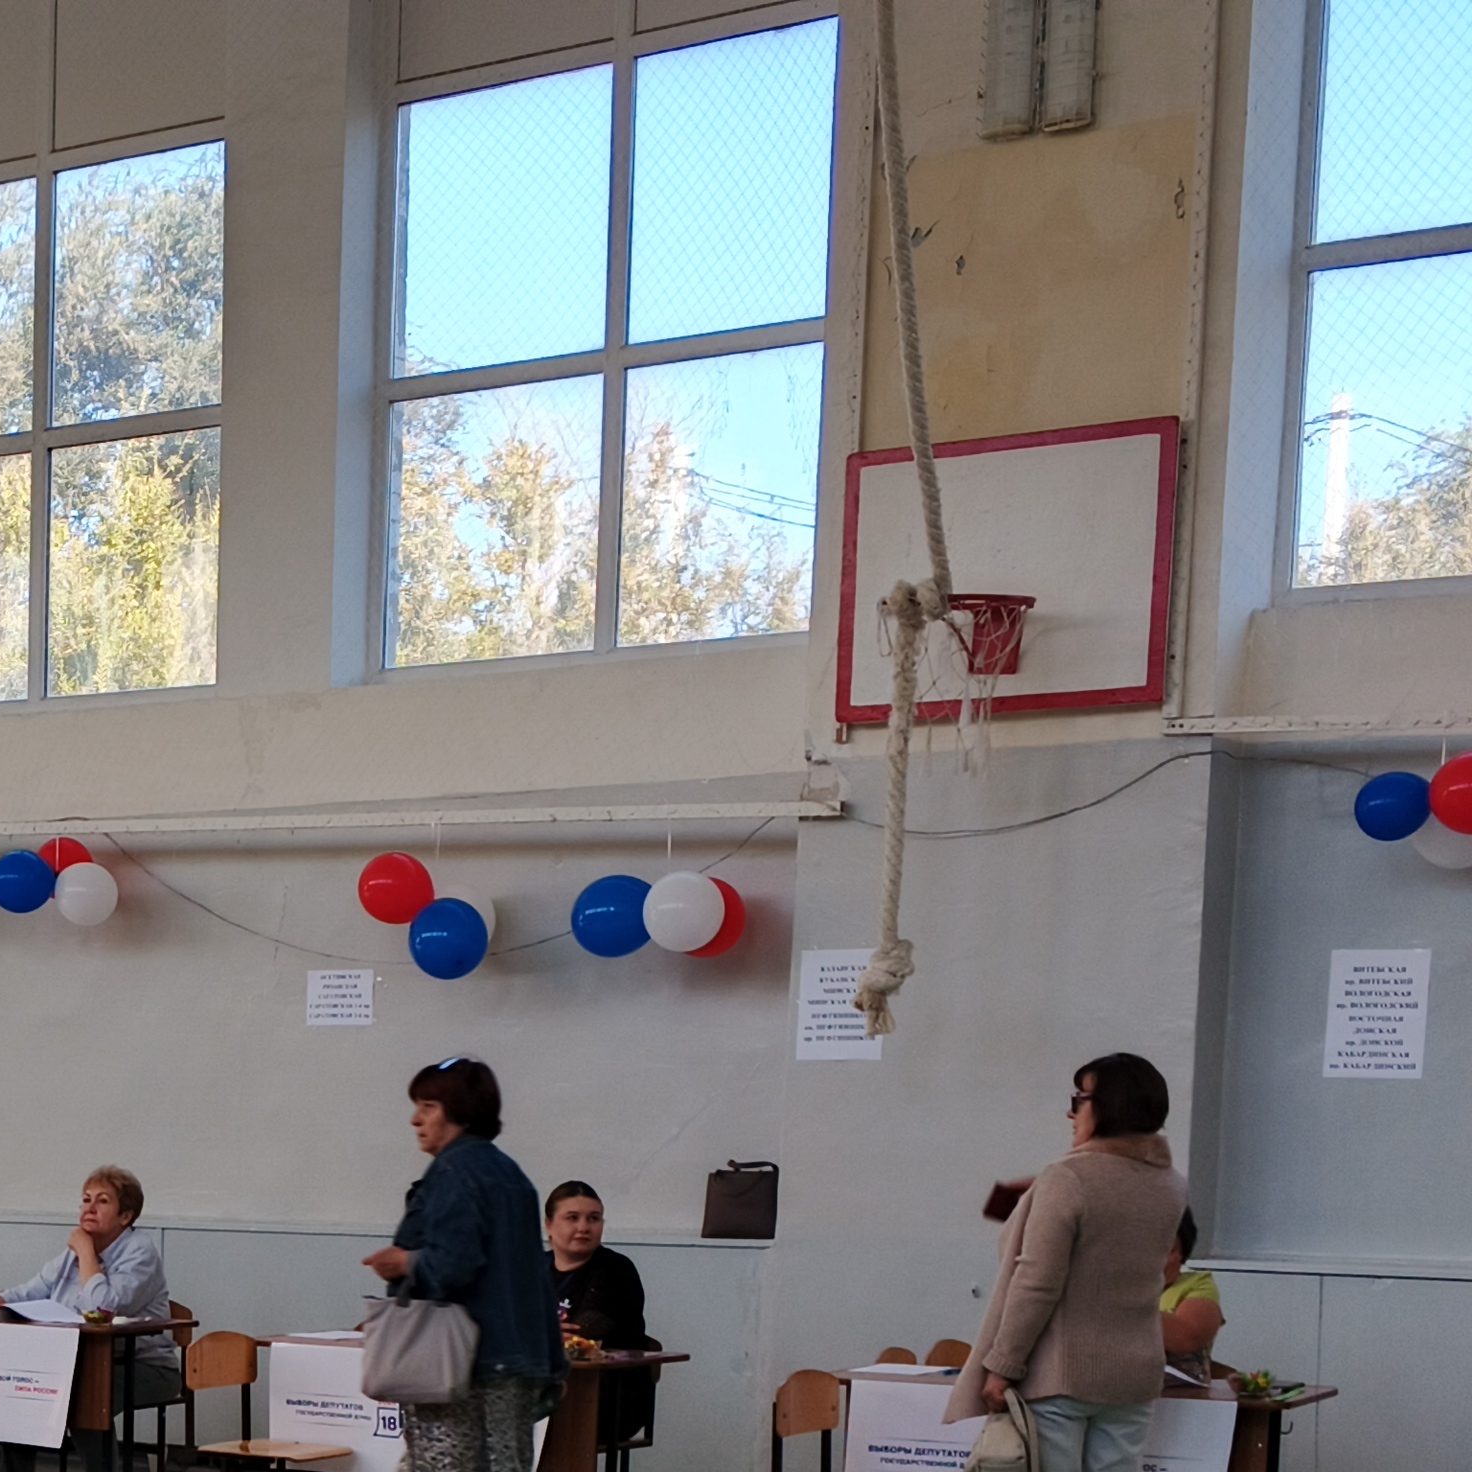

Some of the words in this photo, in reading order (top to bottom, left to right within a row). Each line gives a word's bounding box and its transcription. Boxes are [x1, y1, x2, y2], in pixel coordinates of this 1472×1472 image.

[286, 1398, 319, 1407] ВЫБОРЫ
[320, 1401, 364, 1411] ДЕПУТАТОВ
[381, 1416, 397, 1431] 18
[868, 1444, 912, 1454] ВЫБОРЫ
[880, 1457, 957, 1468] ГОСУДАРСТВЕННОЙ
